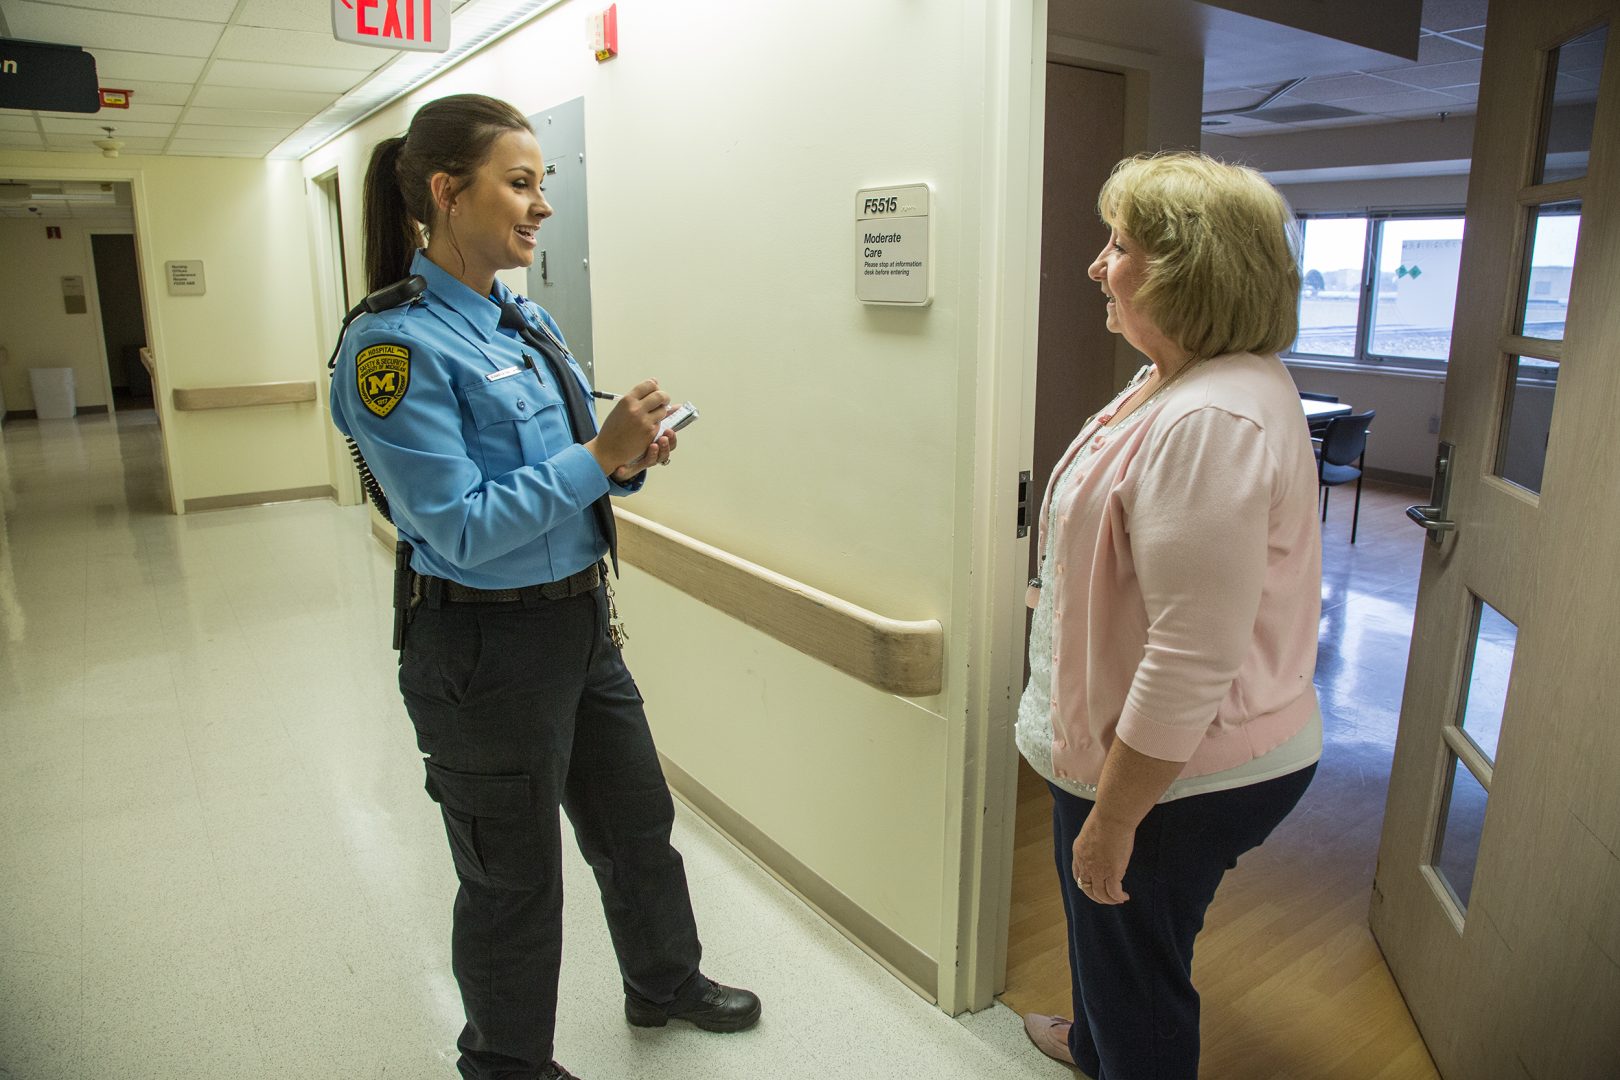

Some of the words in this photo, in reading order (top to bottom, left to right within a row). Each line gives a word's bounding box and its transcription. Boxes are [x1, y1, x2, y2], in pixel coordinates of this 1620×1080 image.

[356, 0, 432, 43] EXIT
[864, 197, 898, 215] F5515
[864, 233, 902, 244] Moderate
[864, 247, 883, 258] Care
[875, 268, 889, 276] before
[890, 268, 910, 277] entering
[368, 348, 395, 356] HOSPITAL
[359, 361, 375, 373] SAFETY
[380, 358, 407, 367] SECURITY
[368, 373, 395, 396] M
